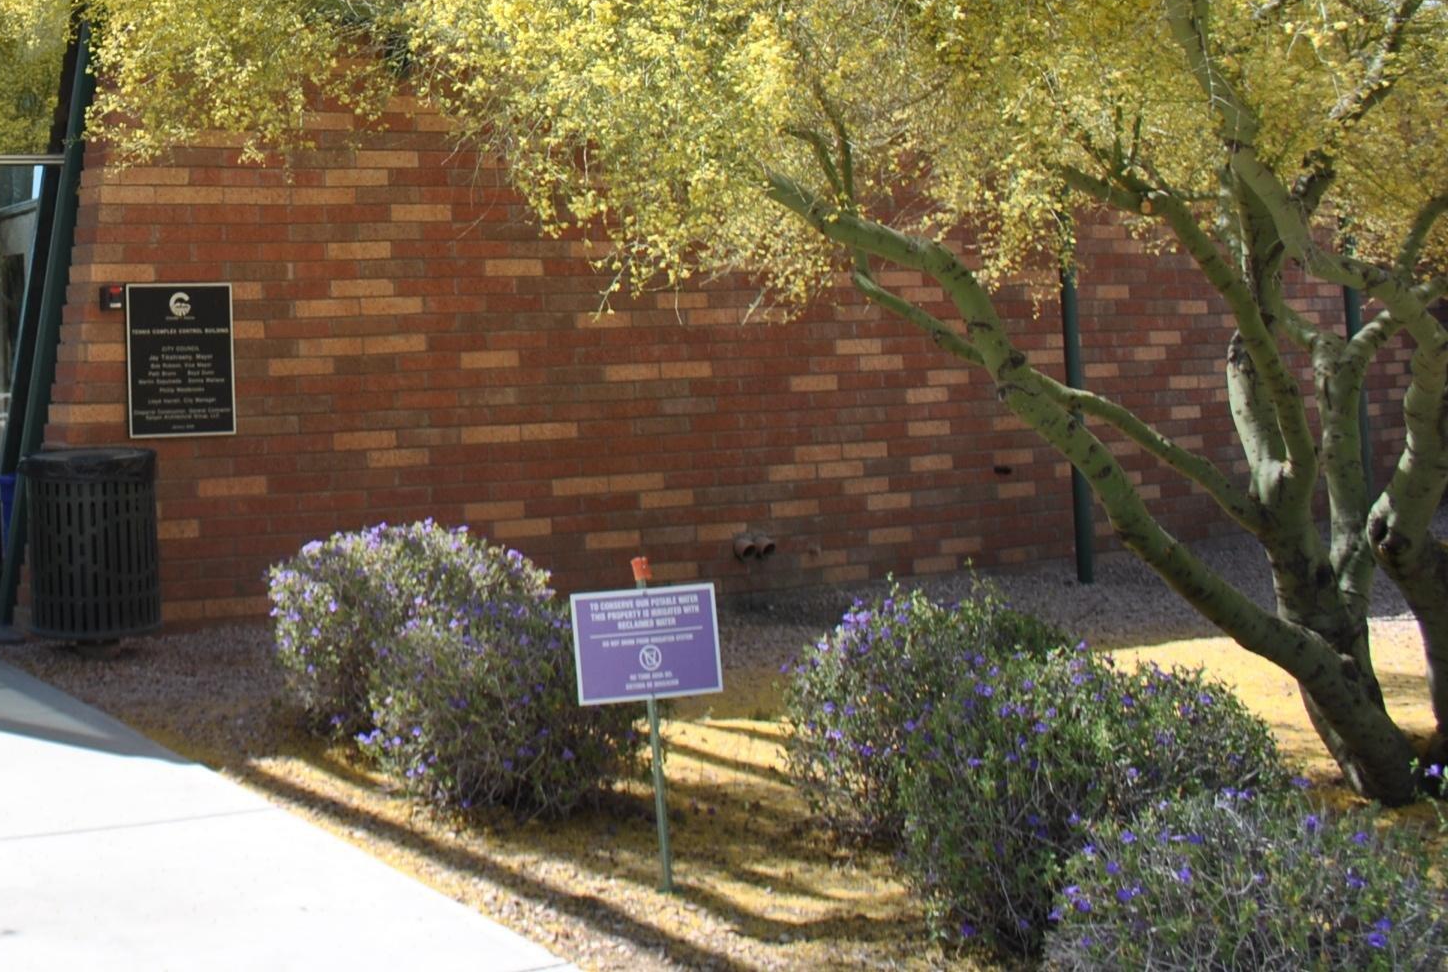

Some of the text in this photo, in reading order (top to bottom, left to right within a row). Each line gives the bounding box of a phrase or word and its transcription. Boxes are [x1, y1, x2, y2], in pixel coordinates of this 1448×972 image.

[589, 594, 699, 612] TO CONSERVE OUR POTABLE WATER
[591, 605, 699, 622] THIS PROPERTY IS IRRIGATED WITH
[617, 617, 676, 630] RECLAIMED WATER
